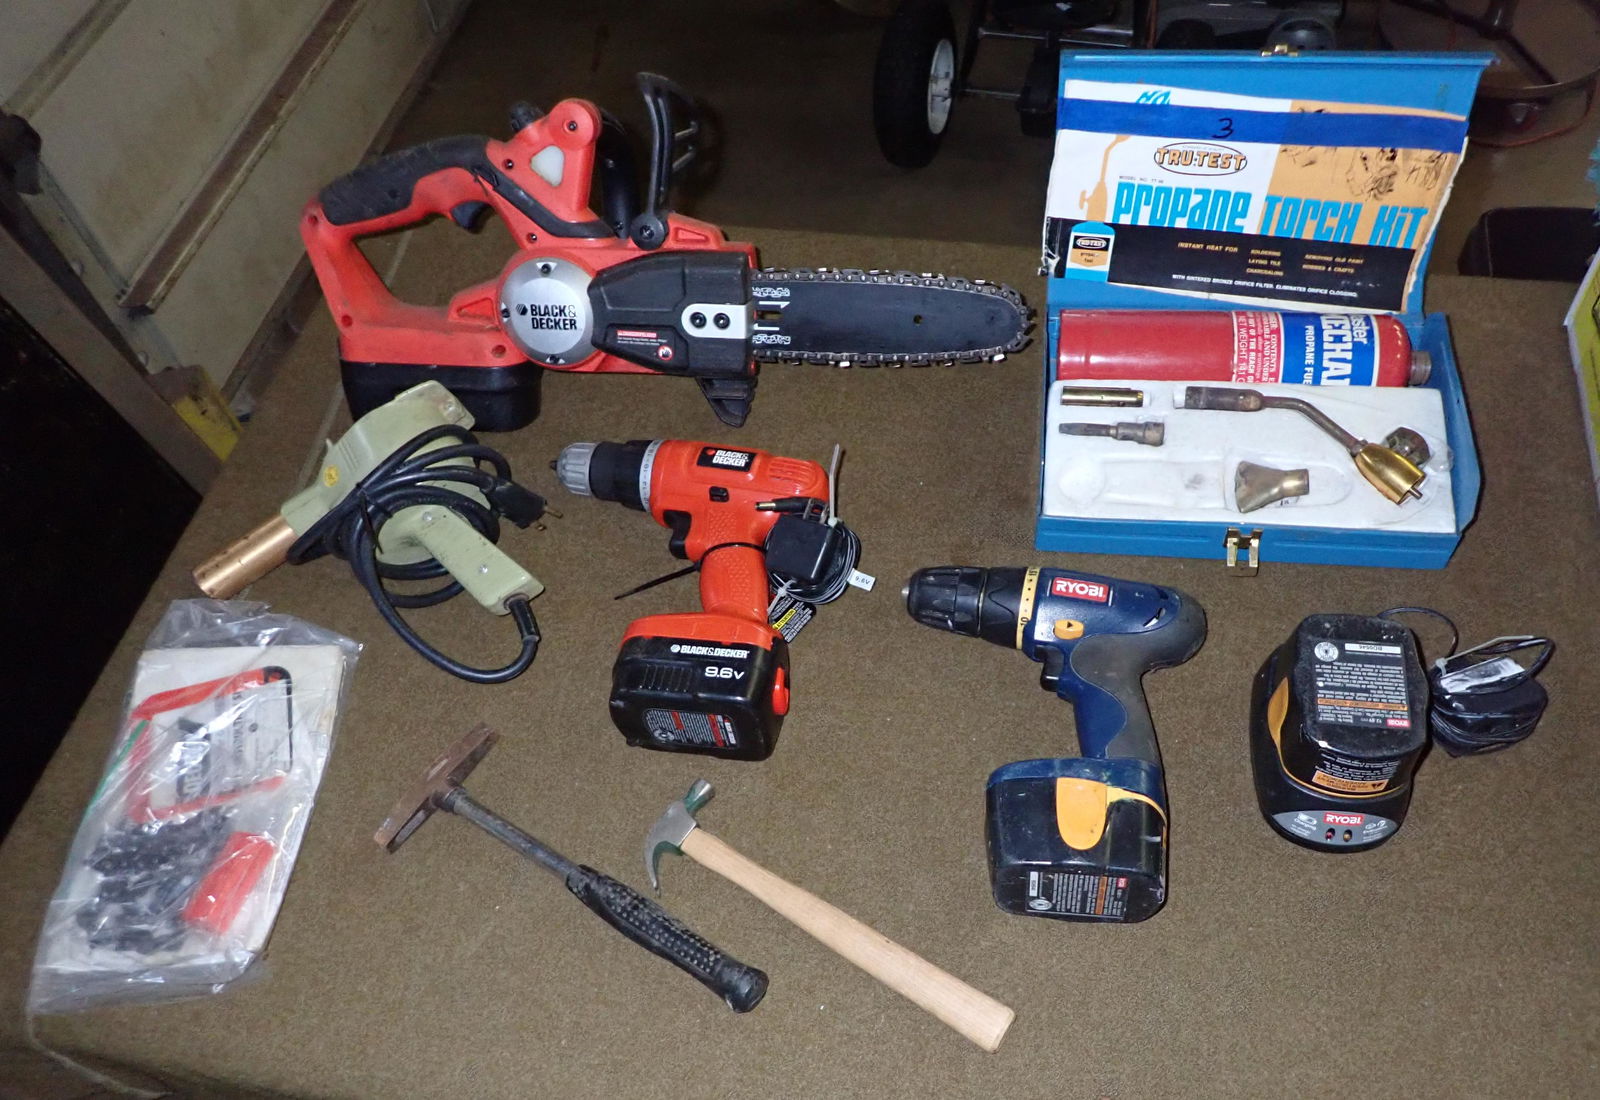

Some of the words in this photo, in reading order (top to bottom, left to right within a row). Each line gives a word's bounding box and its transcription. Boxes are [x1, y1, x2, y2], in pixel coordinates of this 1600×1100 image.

[1212, 117, 1233, 139] 3
[1178, 242, 1204, 250] INSTANT
[1225, 245, 1238, 253] FOR
[530, 303, 577, 319] BLACK&
[531, 316, 578, 332] DECKER
[1269, 335, 1277, 372] CONTENTS
[1305, 326, 1315, 365] PROPANE
[1303, 368, 1314, 384] FUE
[712, 456, 747, 468] DECKER
[1056, 581, 1103, 597] RYOBI
[1325, 814, 1361, 825] RYOBI
